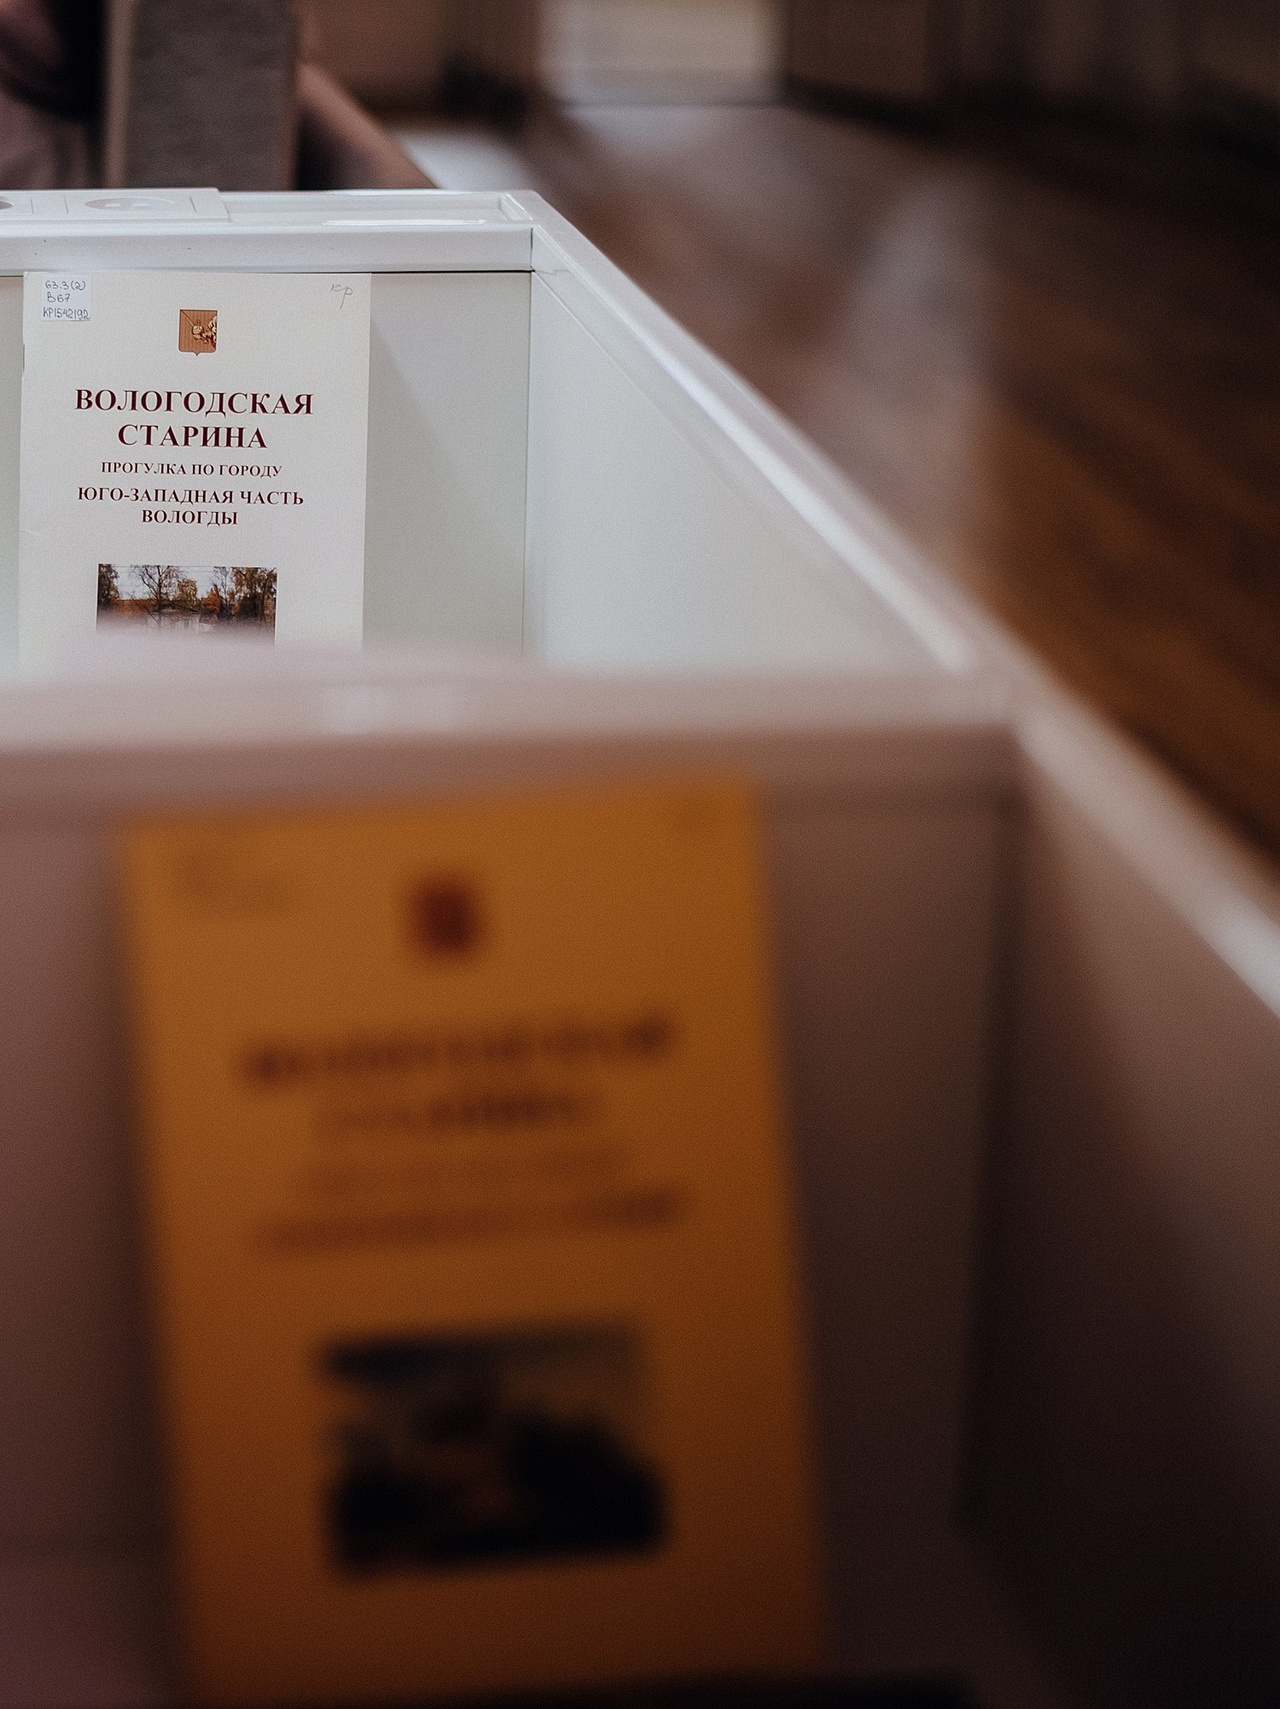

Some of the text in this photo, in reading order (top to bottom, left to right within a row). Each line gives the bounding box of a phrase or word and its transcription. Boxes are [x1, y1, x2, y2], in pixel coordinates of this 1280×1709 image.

[45, 280, 86, 291] 63.3(2)
[75, 388, 314, 418] ВОЛОГОДСКАЯ
[117, 423, 268, 449] СТАРИНА
[101, 461, 283, 479] ПРОГУЛКА ПО ГОРОДУ
[78, 486, 304, 506] ЮГО-ЗАПАДНАЯ ЧАСТЬ
[142, 509, 238, 528] ВОЛОГДЫ
